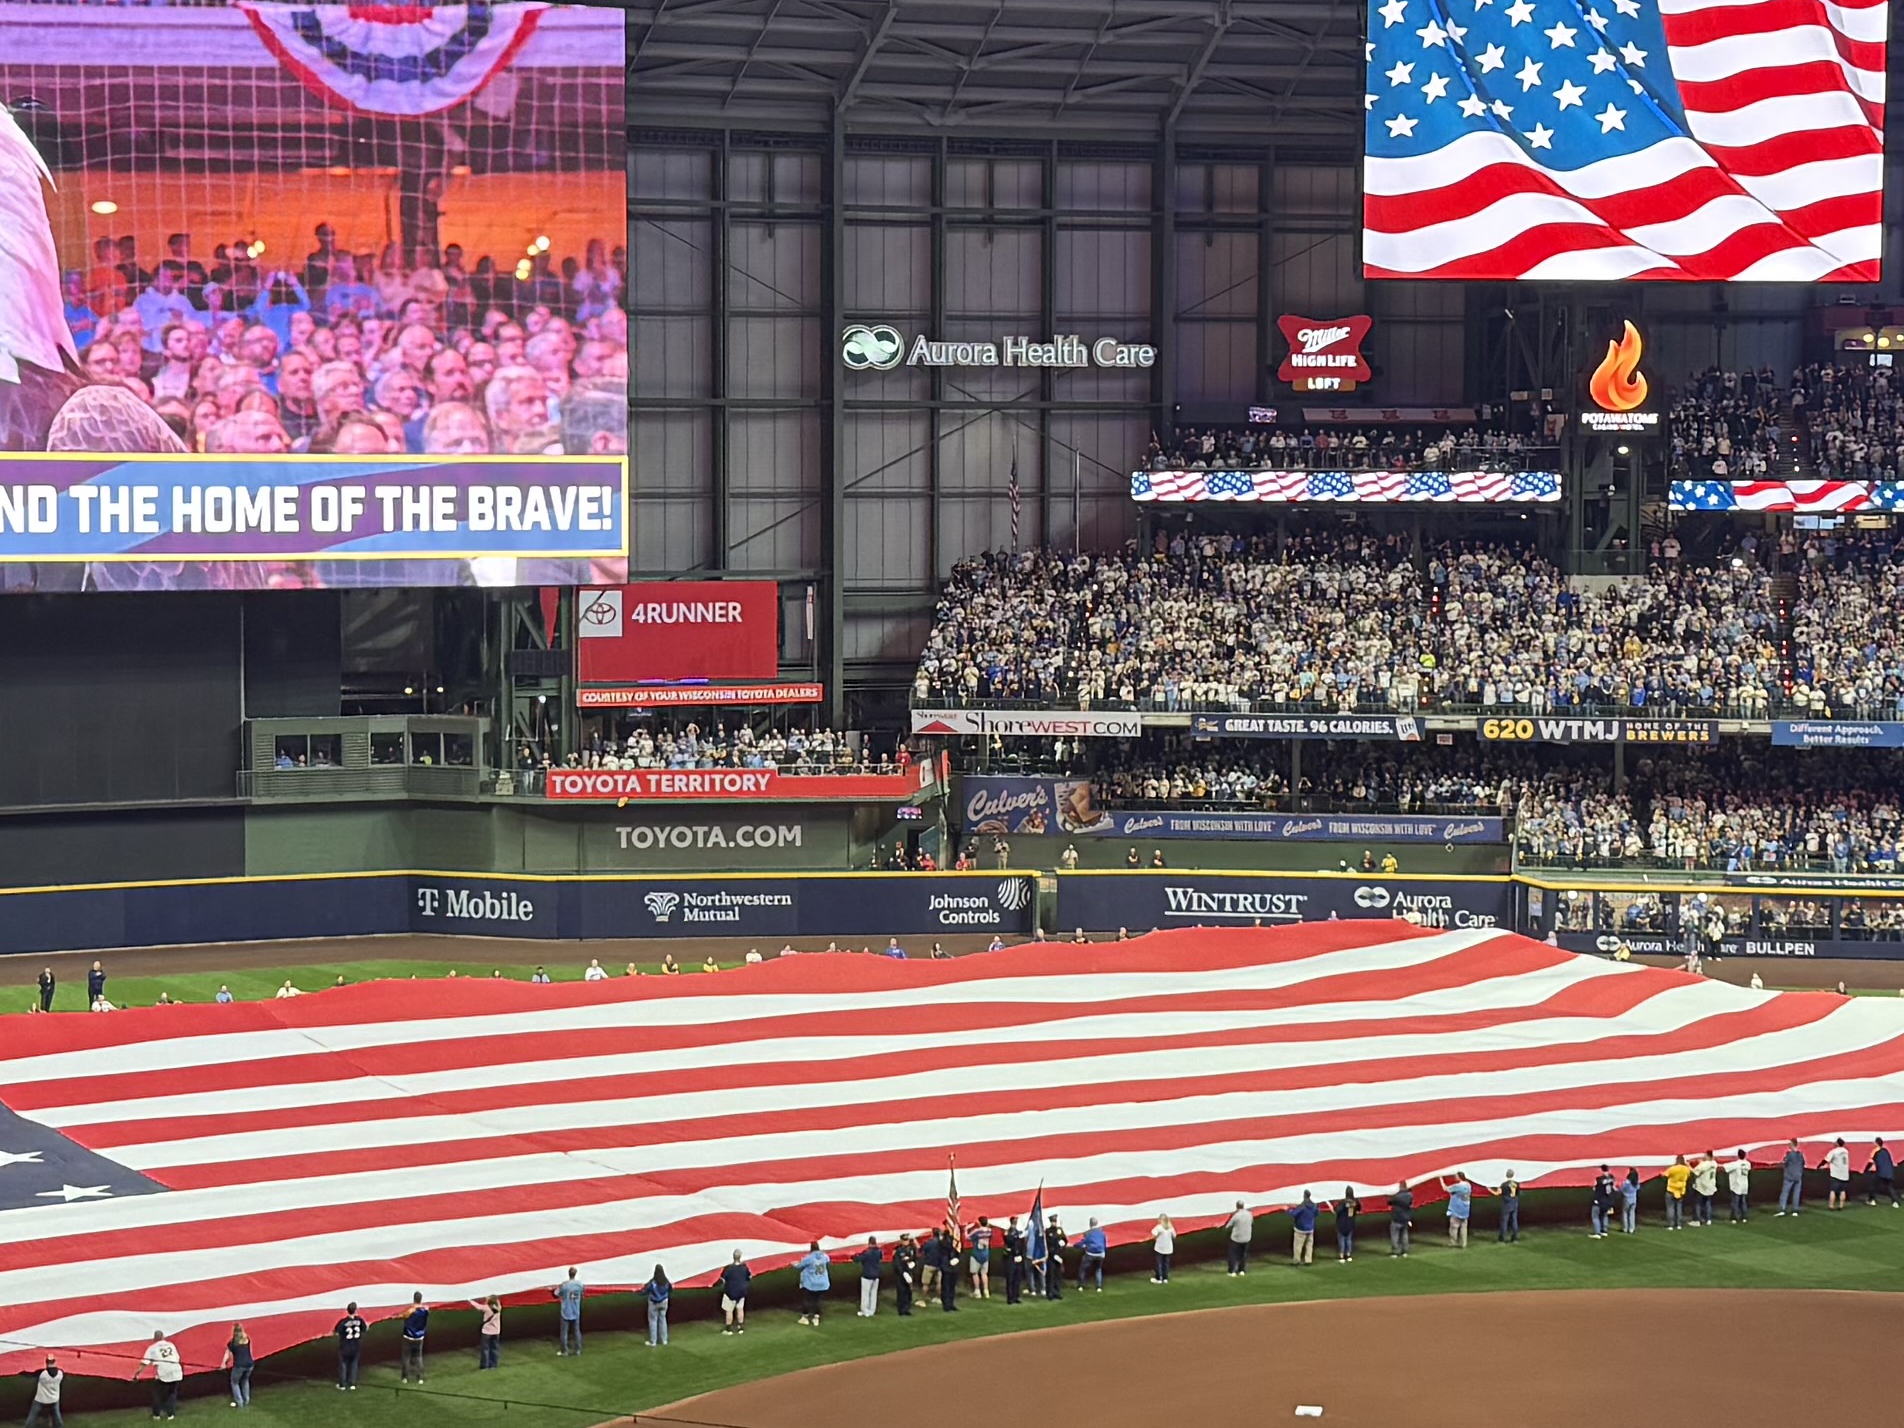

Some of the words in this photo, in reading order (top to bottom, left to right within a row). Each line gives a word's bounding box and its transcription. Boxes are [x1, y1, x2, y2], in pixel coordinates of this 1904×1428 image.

[907, 334, 998, 366] Aurora
[1003, 335, 1088, 368] Health
[1092, 336, 1157, 368] Care
[1327, 354, 1357, 367] LIFE
[70, 484, 160, 534] THE
[172, 484, 301, 534] HOME
[310, 484, 366, 533] OF
[376, 484, 458, 532] THE
[468, 484, 613, 532] BRAVE!
[631, 601, 743, 624] 4RUNNER
[737, 687, 775, 699] TOYOTA
[775, 686, 818, 698] DEALERS
[1225, 718, 1266, 733] GREAT
[1266, 719, 1308, 734] TASTE.
[1309, 720, 1328, 734] 96
[1329, 720, 1394, 735] CALORIES.
[1482, 719, 1534, 739] 620
[1538, 720, 1620, 740] WTMJ
[1626, 722, 1660, 731] HOME
[1665, 722, 1681, 731] OF
[1687, 723, 1710, 731] THE
[1626, 730, 1710, 741] BREWERS
[552, 774, 642, 794] TOYOTA
[646, 772, 771, 793] TERRITORY
[967, 784, 1049, 821] Culver's
[615, 824, 803, 849] TOYOTA.COM
[445, 889, 534, 921] Mobile
[683, 890, 792, 908] Northwestern
[929, 894, 989, 910] Johnson
[1165, 886, 1304, 913] WINTRUST
[1393, 891, 1452, 909] Aurora
[683, 906, 740, 922] Mutual
[939, 909, 1001, 924] Controls
[1392, 908, 1450, 929] Halth
[1454, 909, 1497, 928] Care
[1745, 941, 1815, 956] BULLPEN
